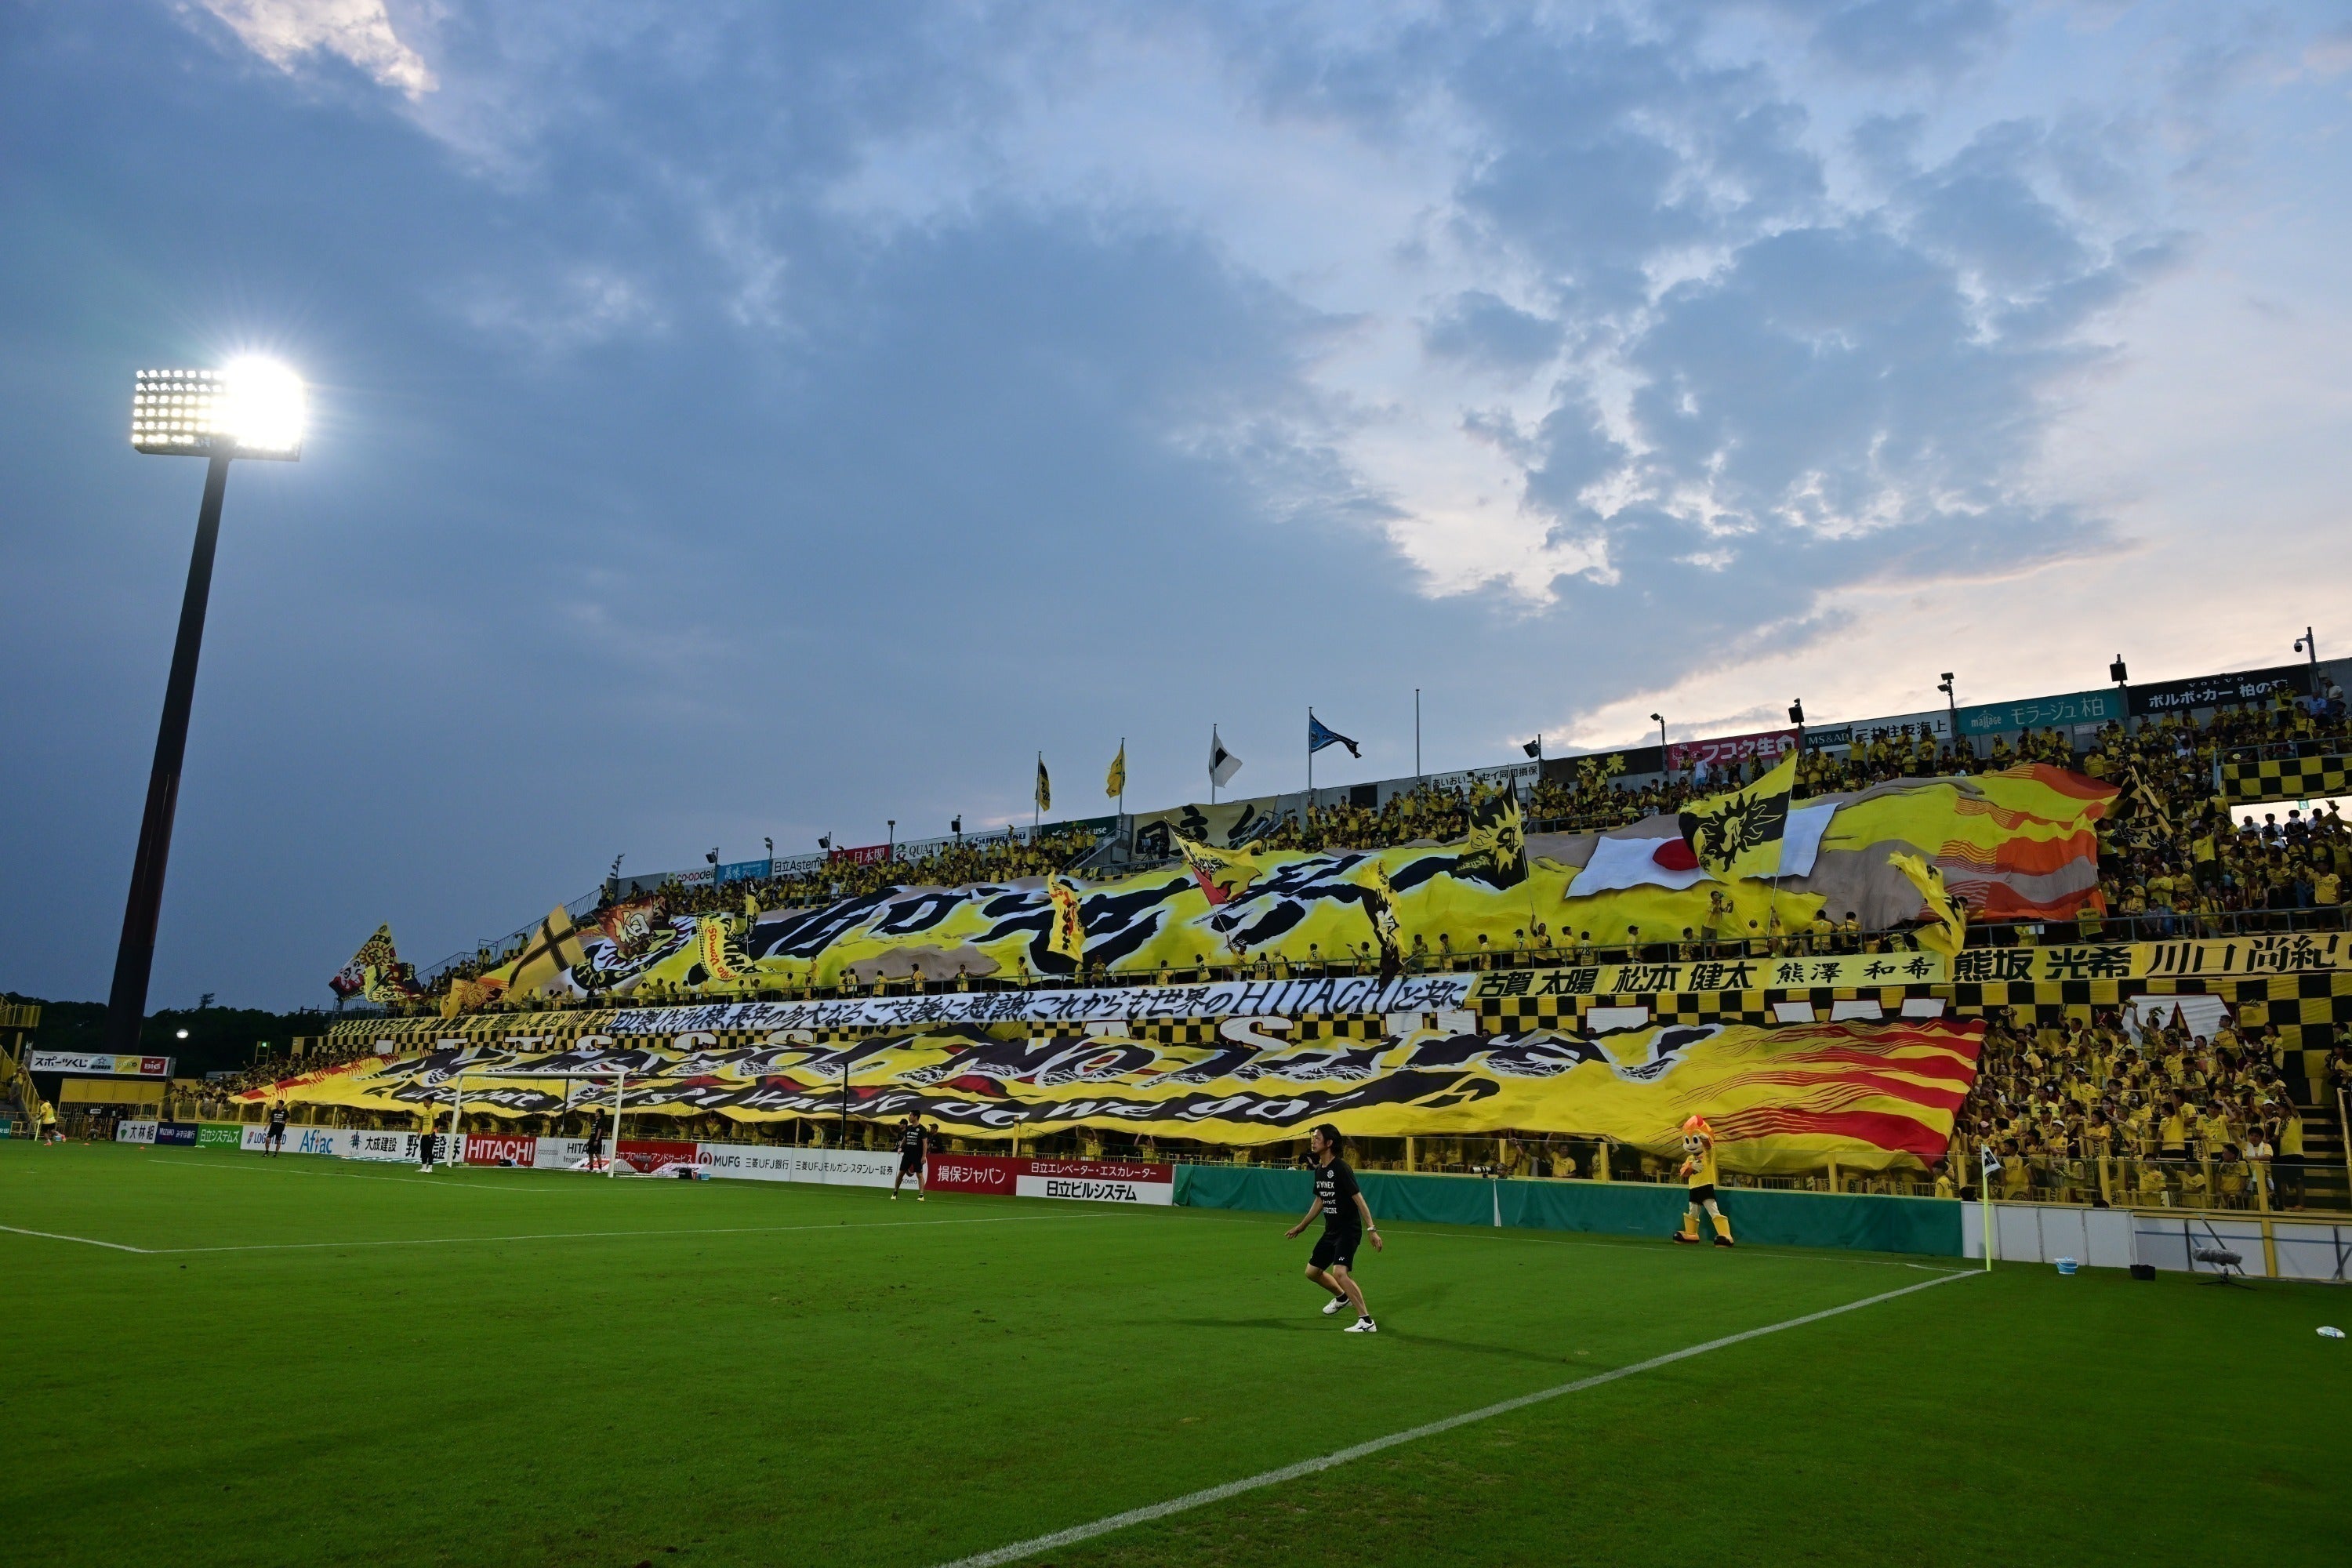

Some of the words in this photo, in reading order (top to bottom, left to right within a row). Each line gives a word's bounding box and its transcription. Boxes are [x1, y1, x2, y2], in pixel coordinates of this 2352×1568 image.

[2187, 675, 2245, 688] VOLVO
[1952, 949, 2034, 981] 熊坂
[2045, 946, 2132, 981] 光希
[2145, 942, 2237, 975] 川口
[2246, 934, 2340, 972] 尚紀
[1610, 964, 1682, 993] 松本
[1688, 961, 1758, 992] 健太
[1776, 962, 1842, 984] 熊澤
[1863, 956, 1935, 979] 和希
[1477, 971, 1535, 997] 古賀
[1536, 968, 1599, 995] 太陽
[35, 1056, 89, 1068] スポーツくじ
[129, 1124, 155, 1141] 大林組
[200, 1128, 239, 1143] 日立システムズ
[365, 1136, 397, 1152] 大成建設
[469, 1139, 533, 1161] HITACHI
[713, 1156, 740, 1168] MUFG
[745, 1157, 789, 1171] 三菱UFJ銀行
[937, 1164, 1006, 1185] 損保ジャパン
[1046, 1180, 1138, 1202] 日立ビルシステム
